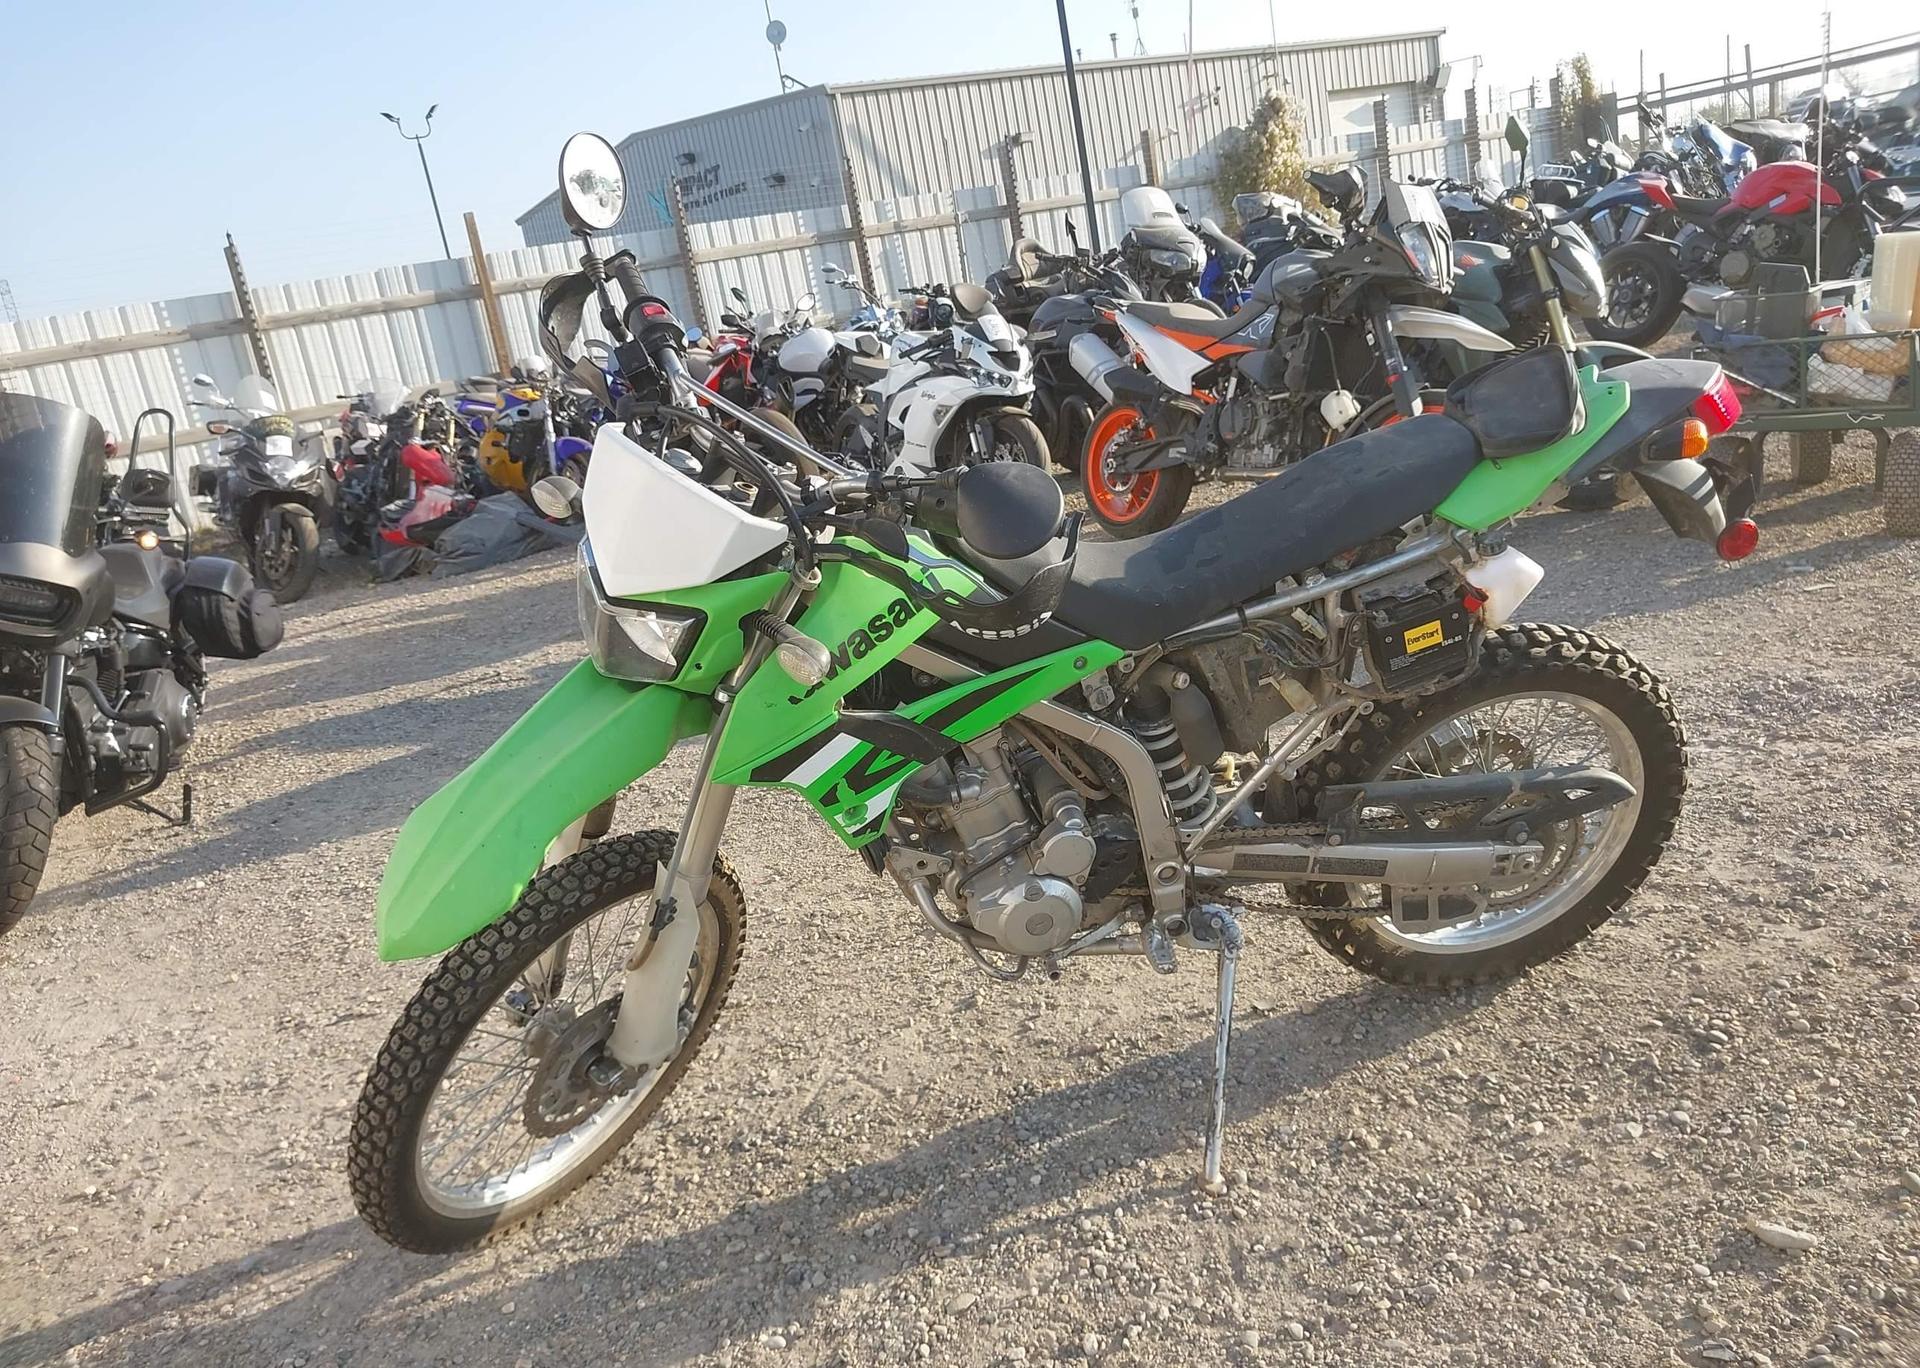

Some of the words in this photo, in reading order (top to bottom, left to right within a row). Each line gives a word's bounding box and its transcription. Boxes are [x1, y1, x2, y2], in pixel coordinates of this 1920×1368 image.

[703, 182, 748, 207] AUCTIONS
[921, 390, 936, 400] Ninja
[1408, 628, 1440, 646] EverStart
